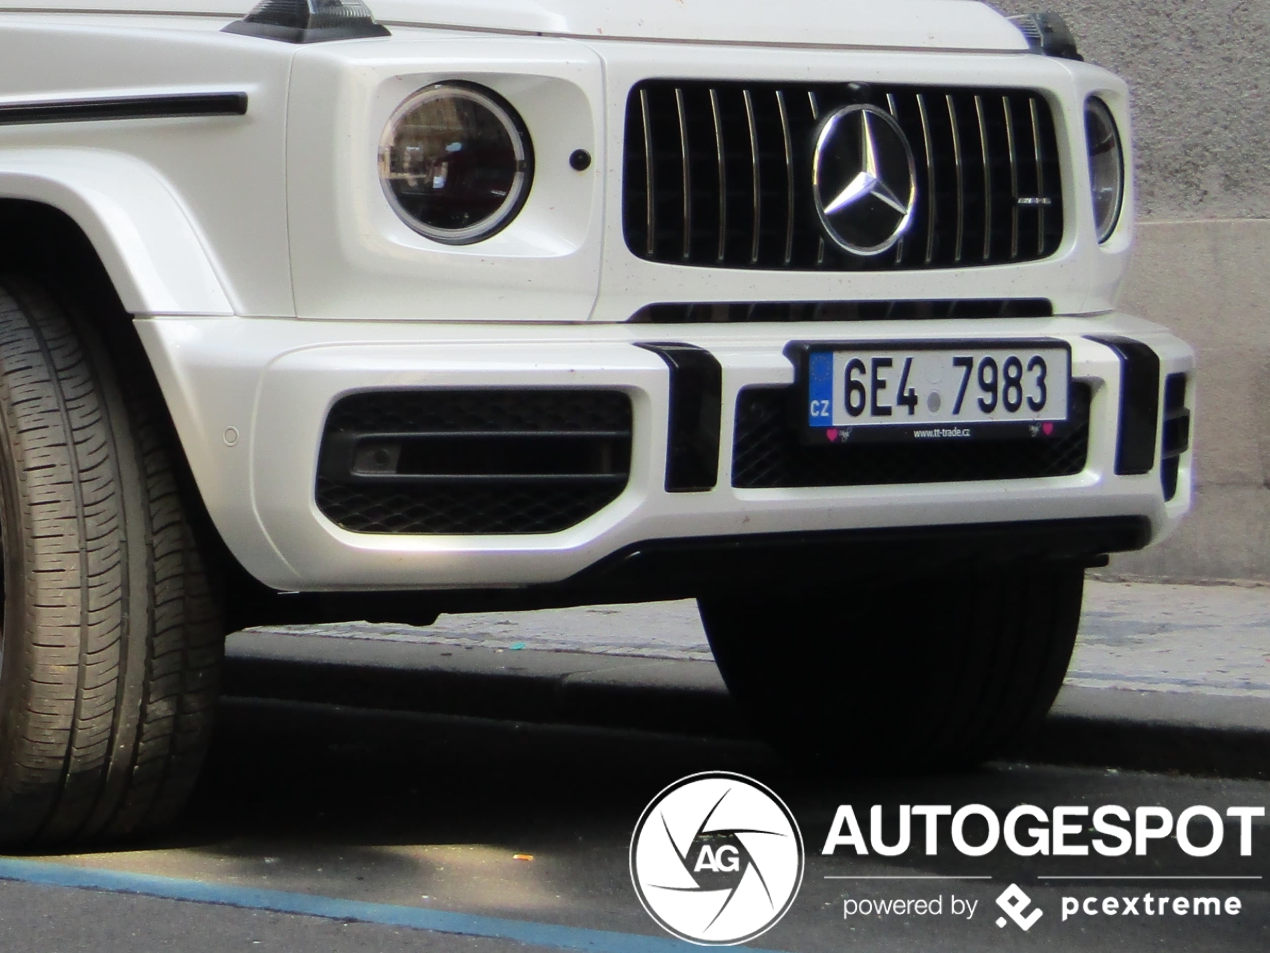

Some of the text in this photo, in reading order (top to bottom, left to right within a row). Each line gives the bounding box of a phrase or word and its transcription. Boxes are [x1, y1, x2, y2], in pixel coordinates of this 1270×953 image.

[844, 355, 1048, 417] 6E4 7983
[810, 400, 829, 416] CZ
[913, 427, 971, 438] www.tt-trade.cz
